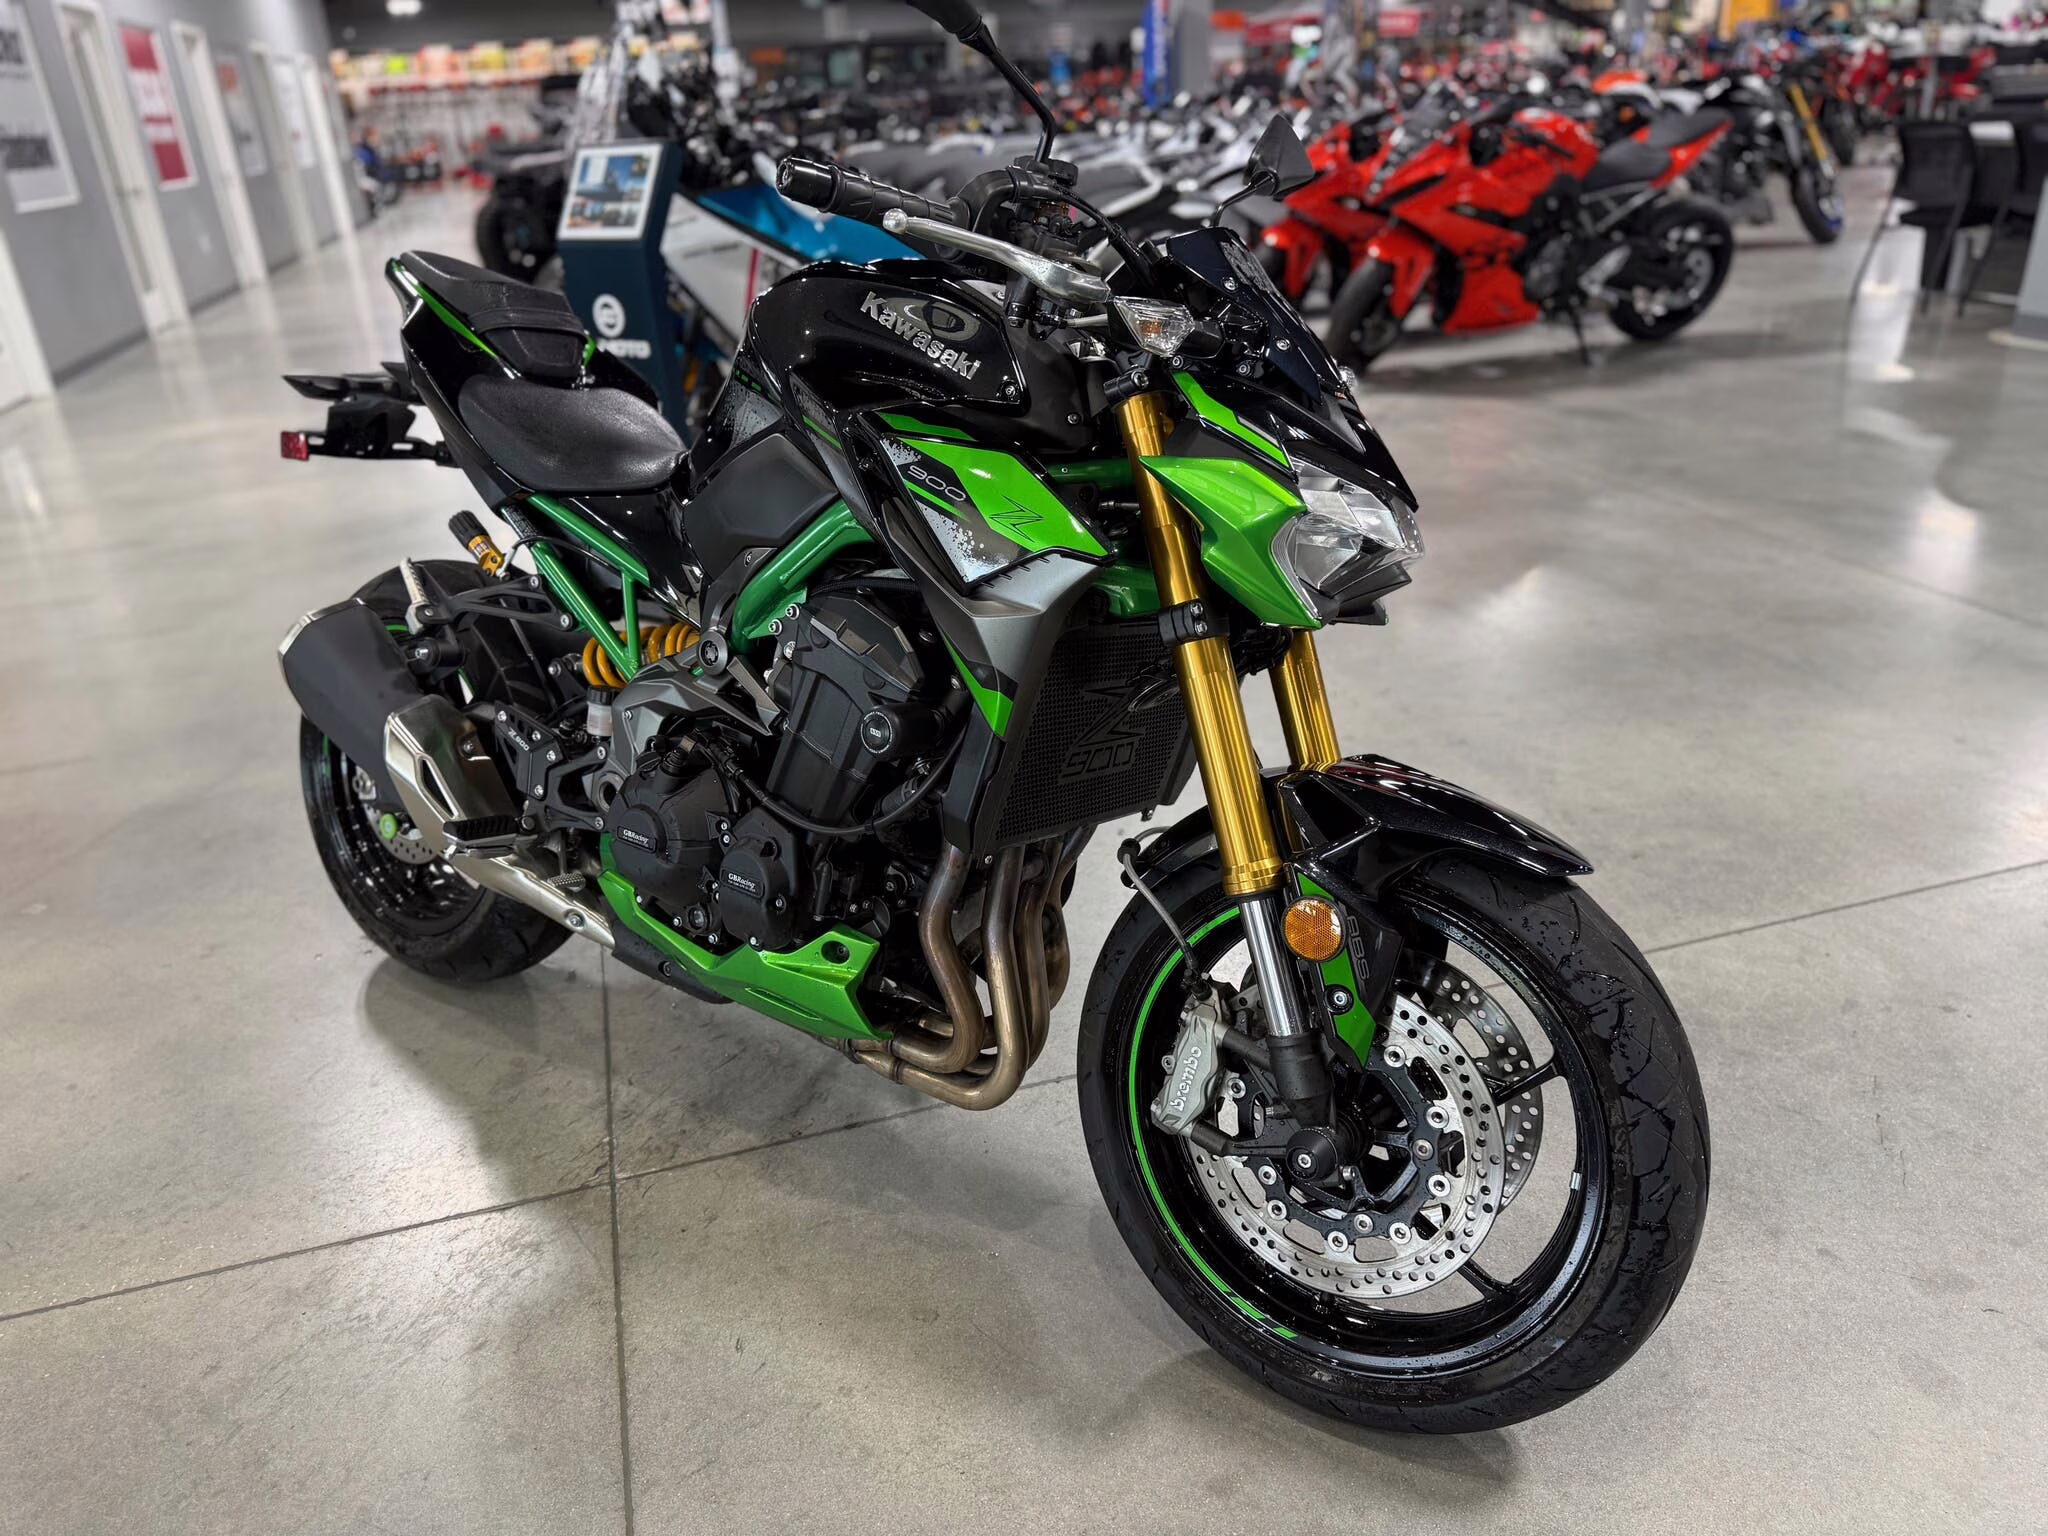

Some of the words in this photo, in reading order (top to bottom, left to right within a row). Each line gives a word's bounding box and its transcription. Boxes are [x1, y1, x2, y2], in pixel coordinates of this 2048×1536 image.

[860, 291, 981, 380] Kawasaki
[907, 465, 967, 501] 900
[1061, 741, 1135, 778] 900
[1346, 915, 1370, 979] ABS
[1169, 1046, 1202, 1112] brembo
